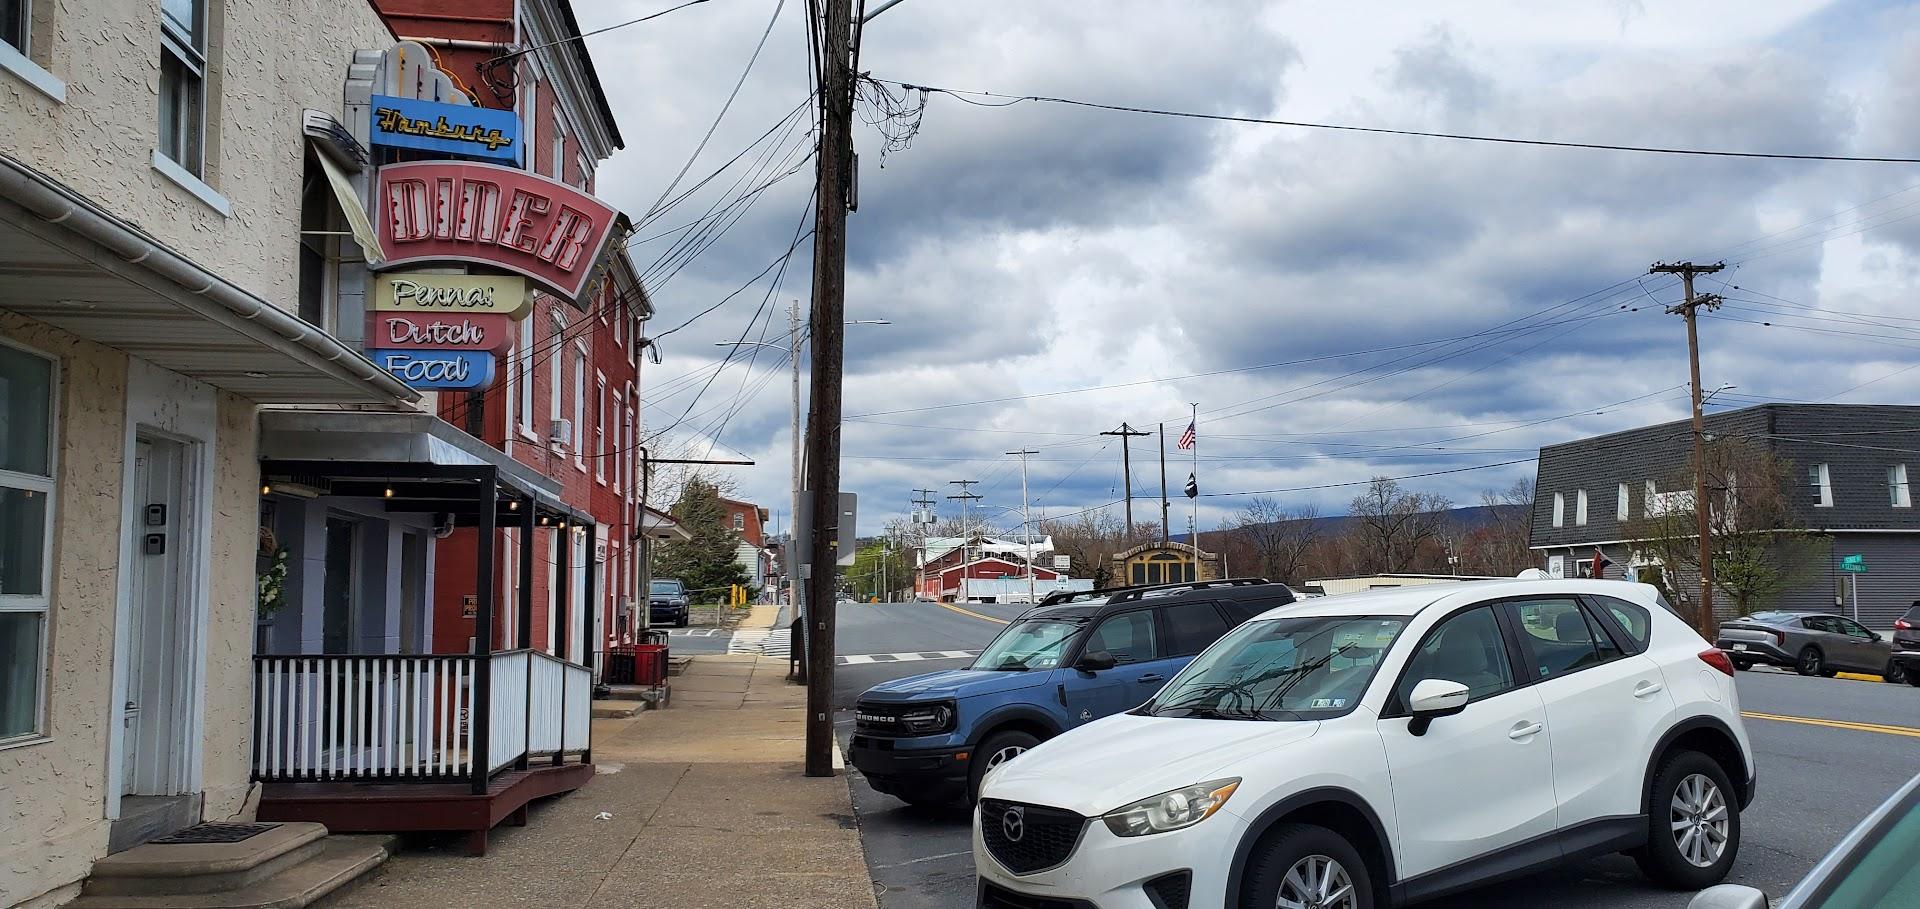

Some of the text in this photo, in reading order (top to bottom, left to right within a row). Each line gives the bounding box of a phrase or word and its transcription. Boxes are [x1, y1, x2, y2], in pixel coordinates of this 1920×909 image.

[377, 107, 512, 149] Hamburg
[386, 178, 595, 272] DINER
[385, 317, 485, 344] Dutch
[385, 355, 468, 381] Food
[856, 714, 895, 722] BRONCO
